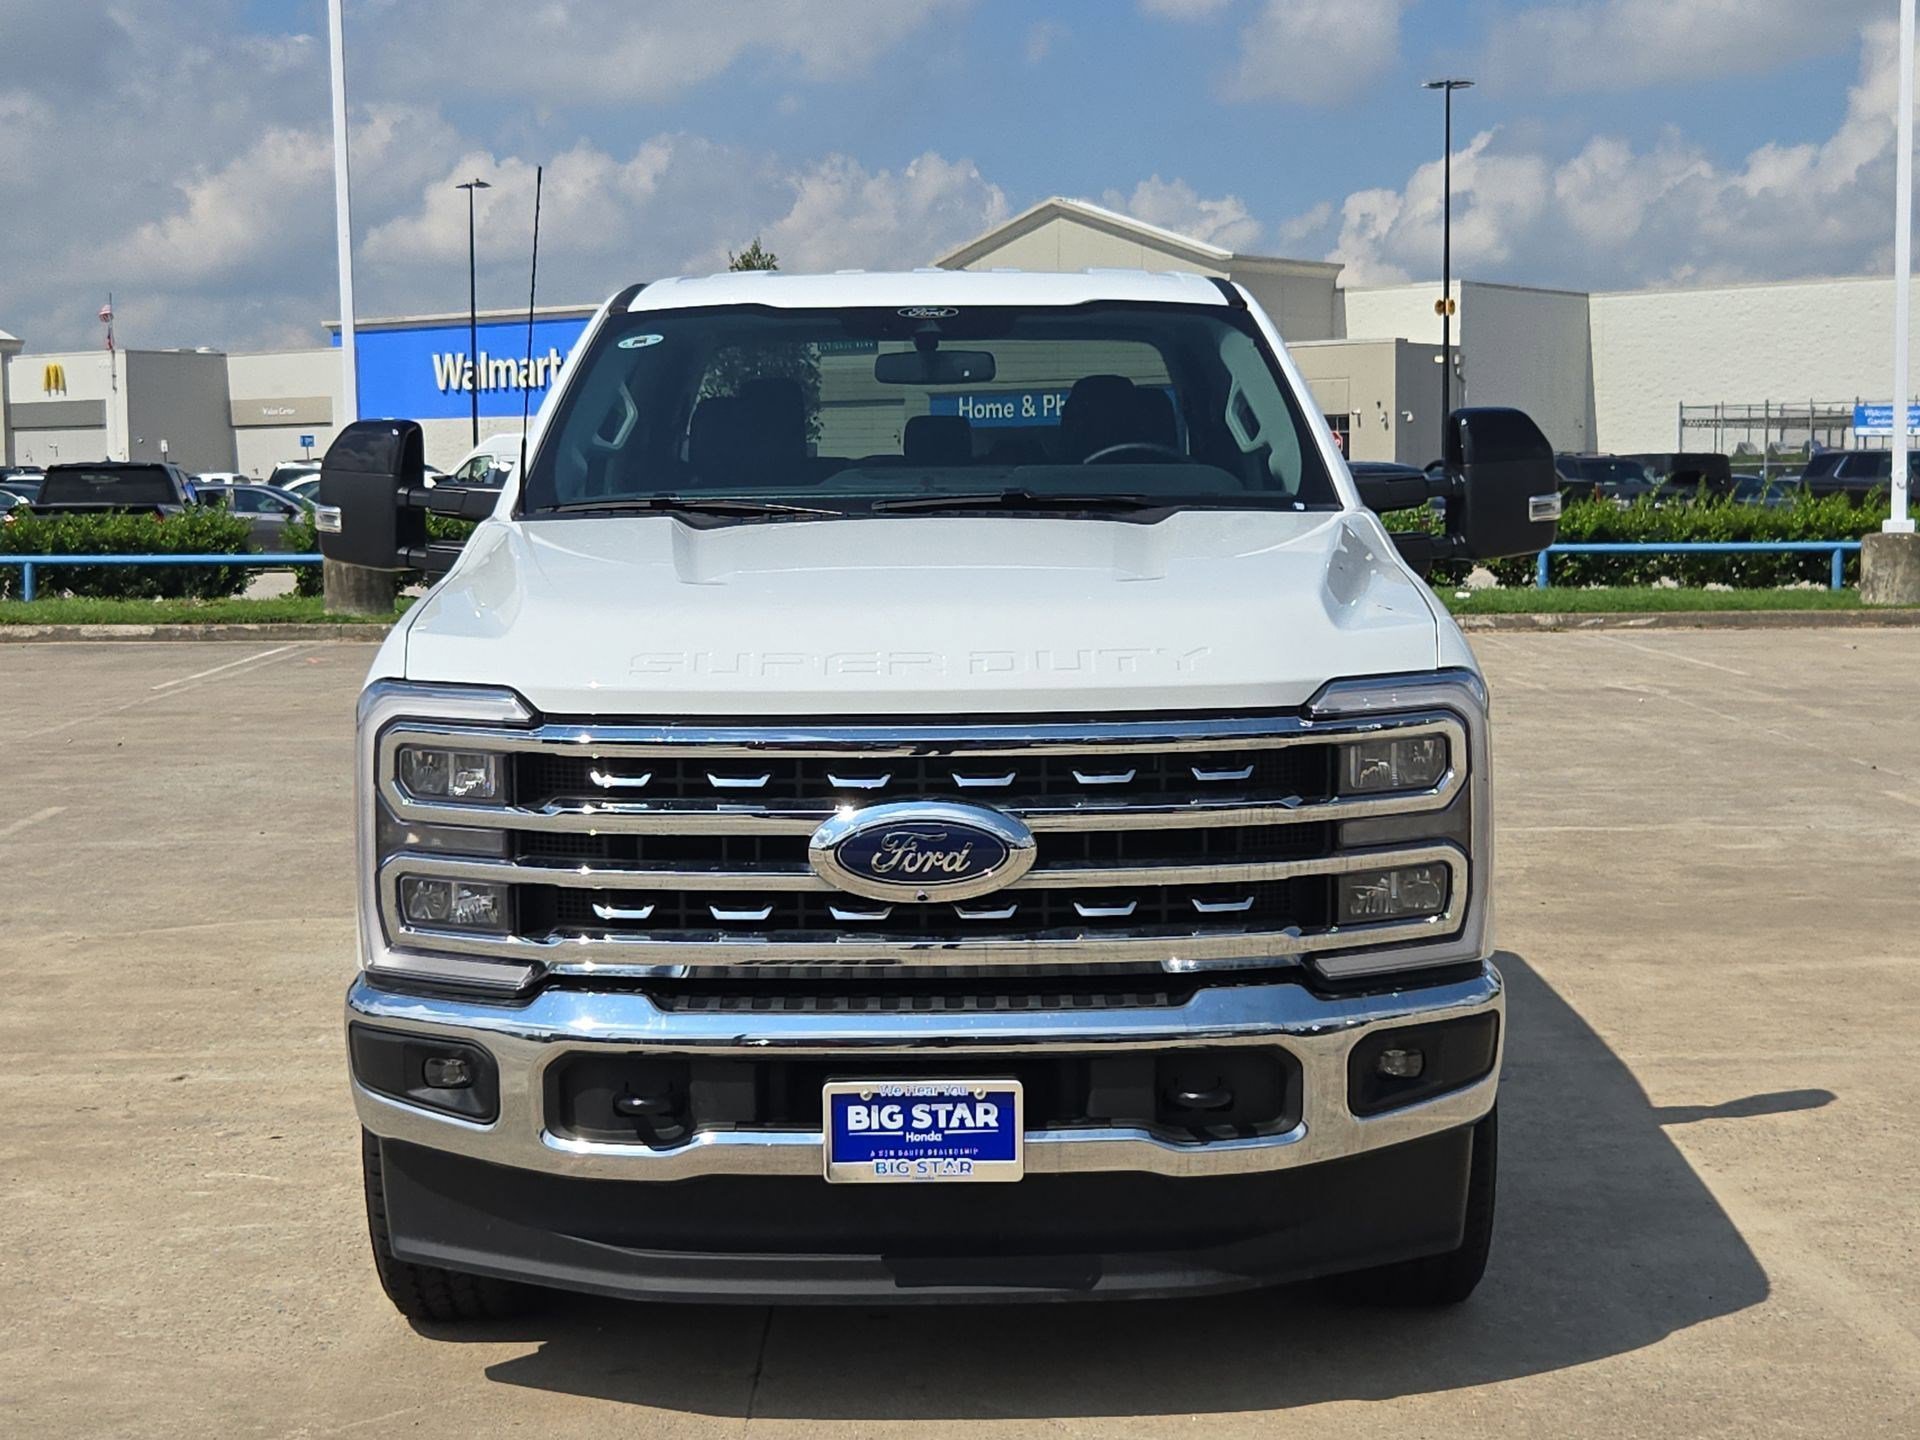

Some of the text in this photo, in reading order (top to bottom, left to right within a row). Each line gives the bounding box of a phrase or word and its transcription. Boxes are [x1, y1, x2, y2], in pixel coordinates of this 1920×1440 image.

[432, 348, 562, 391] Walmart
[958, 396, 1015, 419] Home
[1022, 395, 1036, 417] &
[628, 646, 1212, 677] SUPER DUTY
[870, 830, 974, 874] Ford
[847, 1102, 999, 1131] BIG STAR
[905, 1130, 942, 1143] Honda
[874, 1159, 973, 1175] BIG STAR
